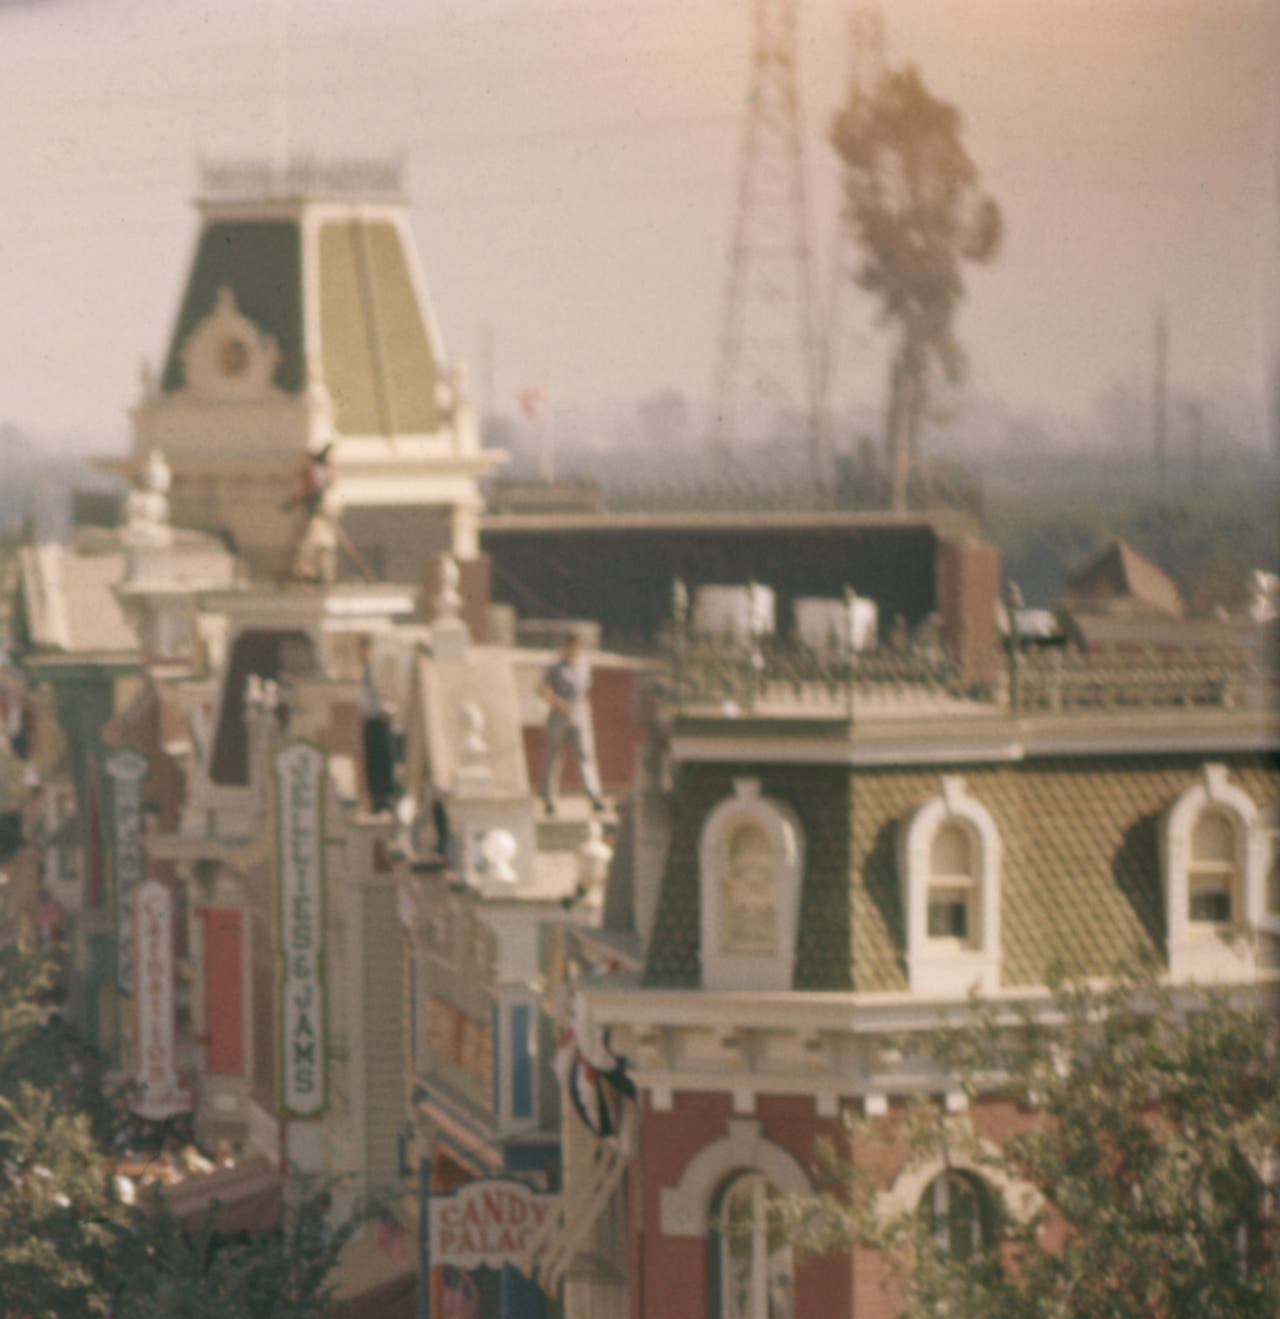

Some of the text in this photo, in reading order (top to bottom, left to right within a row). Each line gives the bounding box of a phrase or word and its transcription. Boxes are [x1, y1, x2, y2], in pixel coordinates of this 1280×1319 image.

[289, 754, 316, 950] JELLIES
[293, 986, 317, 1095] JAMS
[441, 1190, 549, 1228] CANDY
